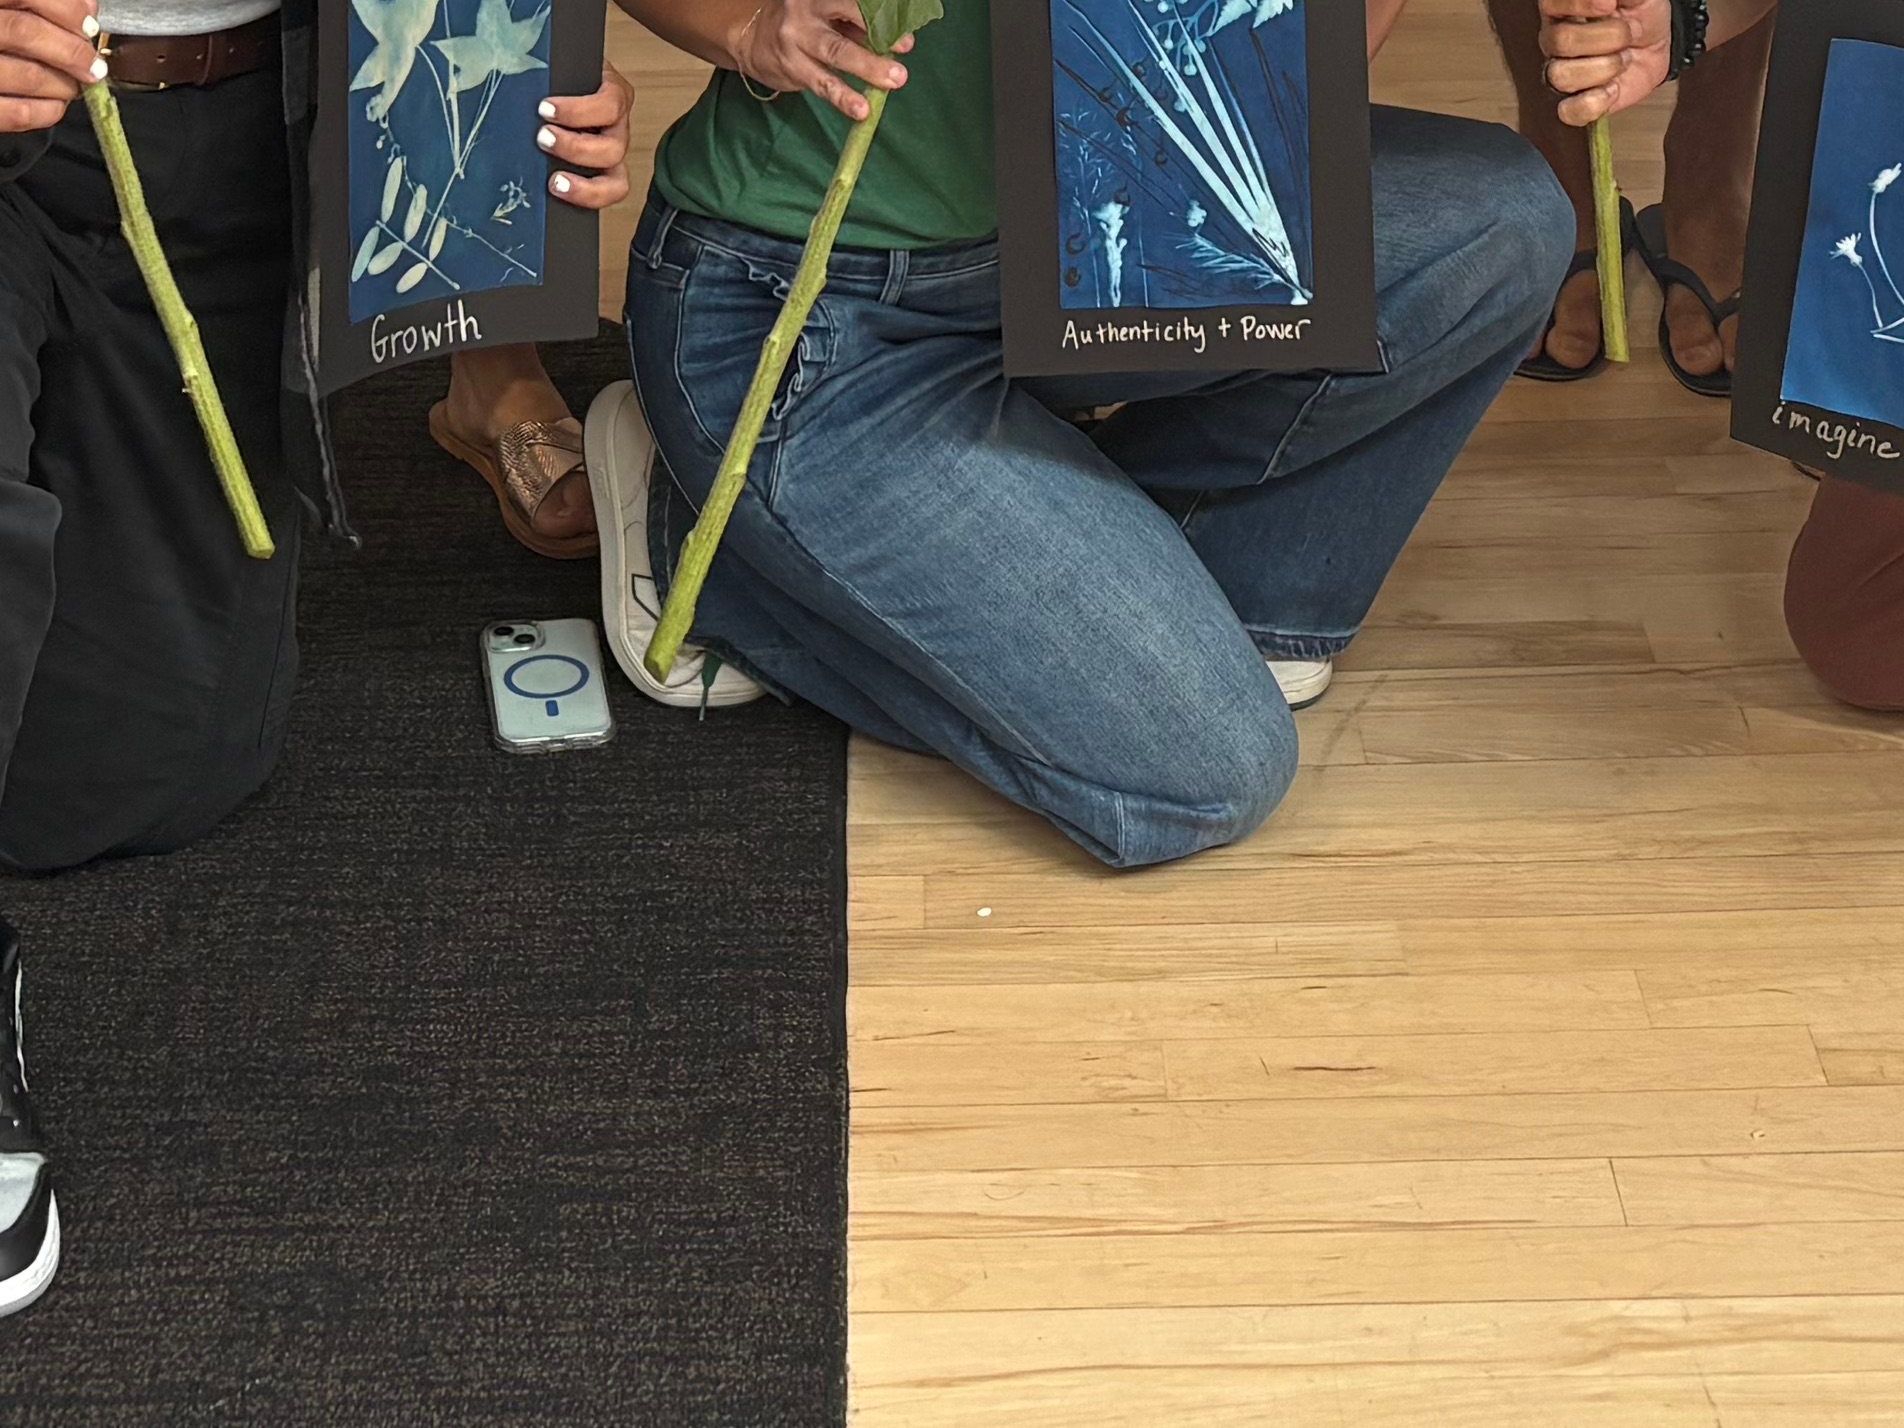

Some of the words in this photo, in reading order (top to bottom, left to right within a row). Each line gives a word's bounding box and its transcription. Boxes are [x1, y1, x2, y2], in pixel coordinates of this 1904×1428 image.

[371, 298, 483, 364] Growth
[1061, 315, 1206, 353] Authenticity
[1239, 314, 1312, 342] Power
[1770, 401, 1901, 461] imagine
